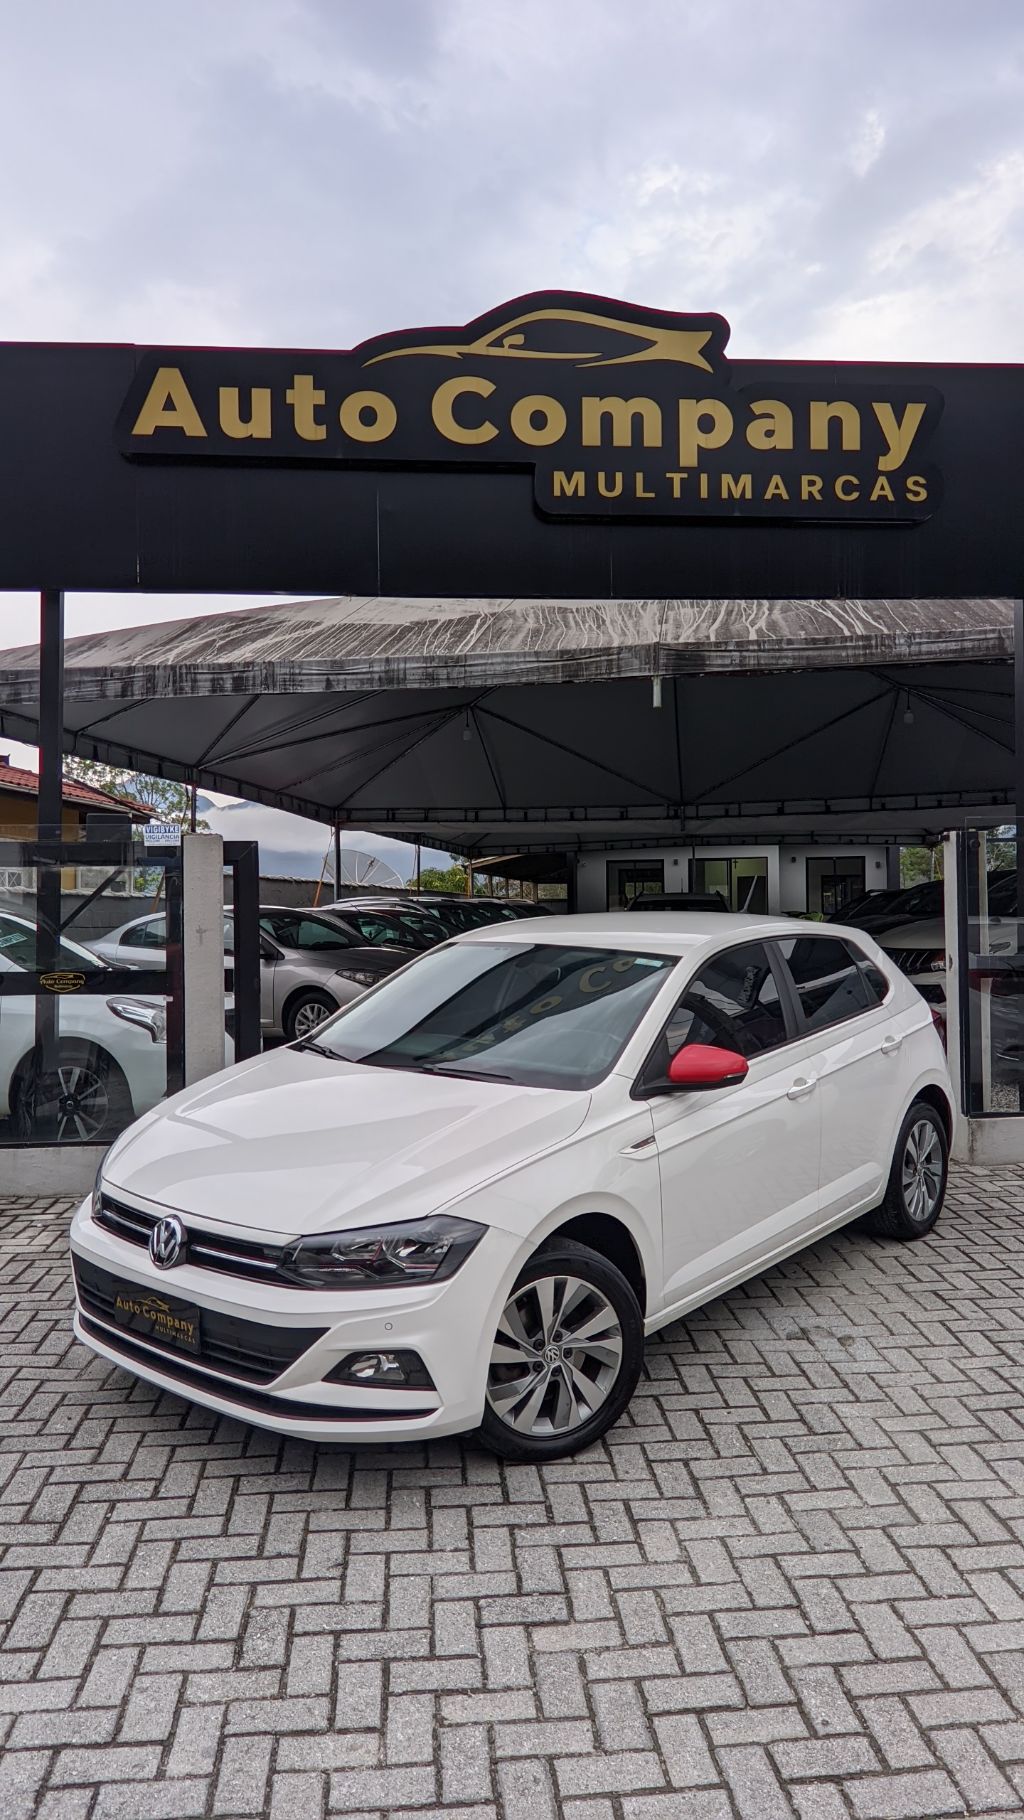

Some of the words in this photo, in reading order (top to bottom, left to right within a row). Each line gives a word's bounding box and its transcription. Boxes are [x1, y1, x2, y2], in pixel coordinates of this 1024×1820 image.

[131, 367, 398, 443] Auto
[431, 375, 927, 472] Company
[553, 470, 929, 502] MULTIMARCAS
[146, 825, 179, 833] VIGIBYKE
[116, 1296, 140, 1314] Auto
[142, 1306, 194, 1335] Company
